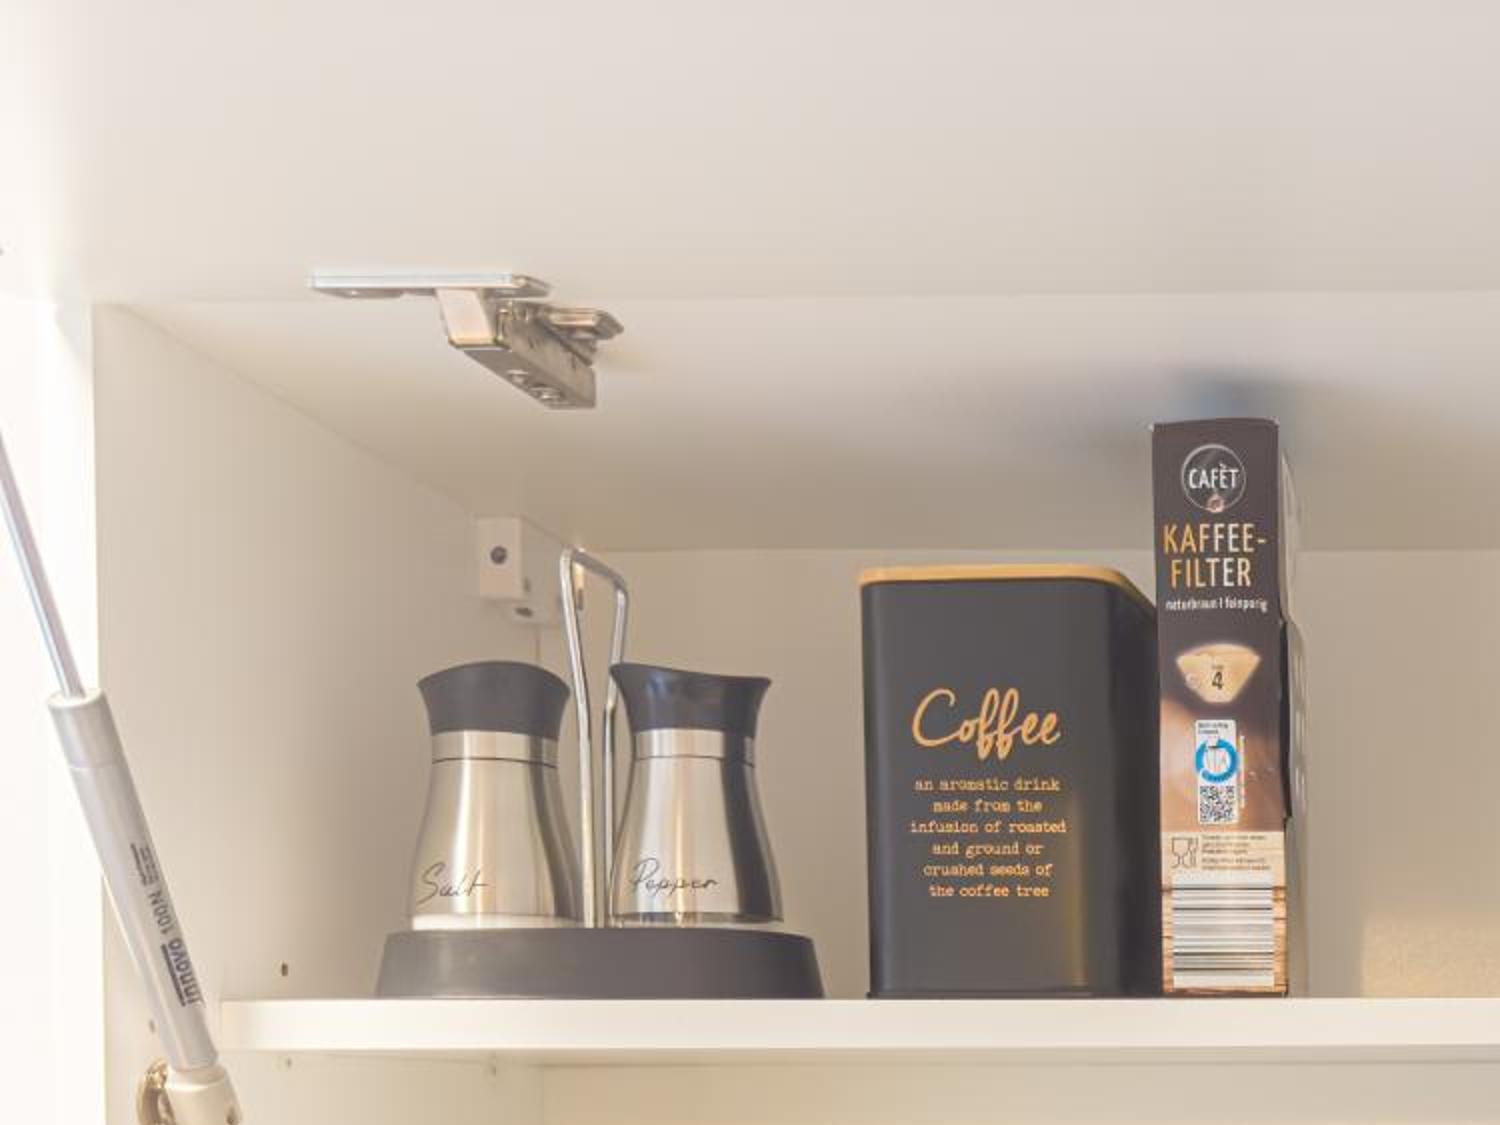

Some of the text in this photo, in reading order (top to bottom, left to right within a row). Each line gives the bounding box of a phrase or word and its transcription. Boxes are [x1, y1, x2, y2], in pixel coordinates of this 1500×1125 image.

[1163, 523, 1267, 553] KAFFEE-
[1170, 557, 1252, 587] FILTER
[1211, 671, 1224, 690] 4
[911, 687, 1061, 760] Coffee
[914, 776, 1061, 791] an aromatic drink
[932, 799, 1044, 812] made from the
[911, 819, 1067, 833] infusion of roasted
[932, 842, 1045, 859] and ground or
[632, 857, 719, 895] Pepper
[923, 863, 1053, 876] crushed seeds of
[417, 861, 489, 905] Salt
[929, 884, 1050, 897] the coffee tree
